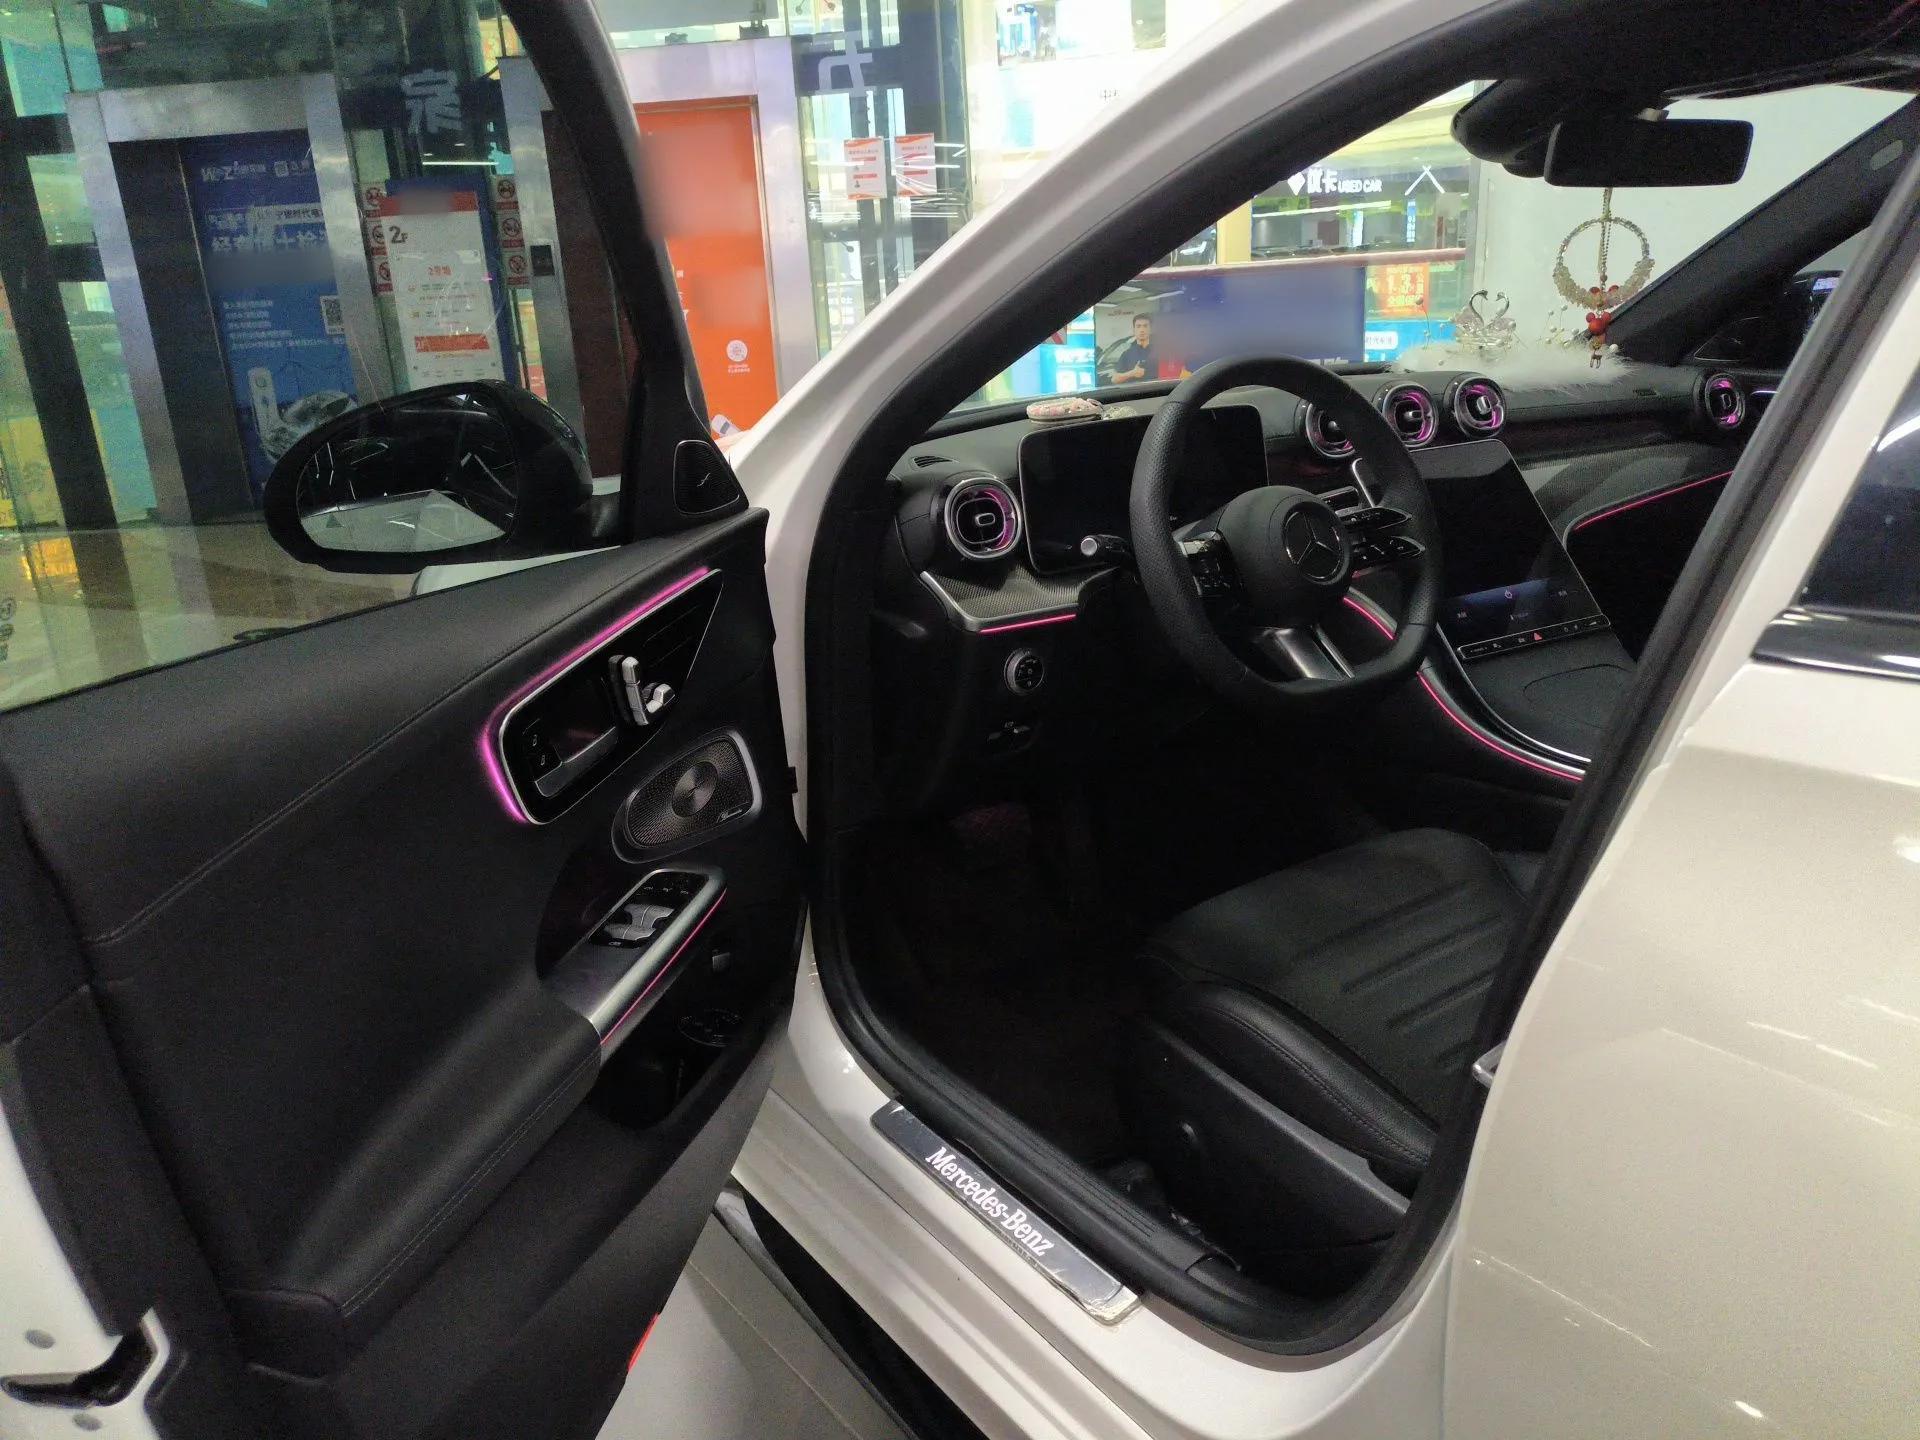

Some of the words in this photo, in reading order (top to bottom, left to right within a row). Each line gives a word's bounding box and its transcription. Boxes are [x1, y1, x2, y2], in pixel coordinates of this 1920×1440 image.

[1338, 179, 1362, 194] USED
[1362, 178, 1383, 194] CAR
[388, 225, 409, 244] 2F
[926, 1146, 1054, 1256] Mercedes-Benz
